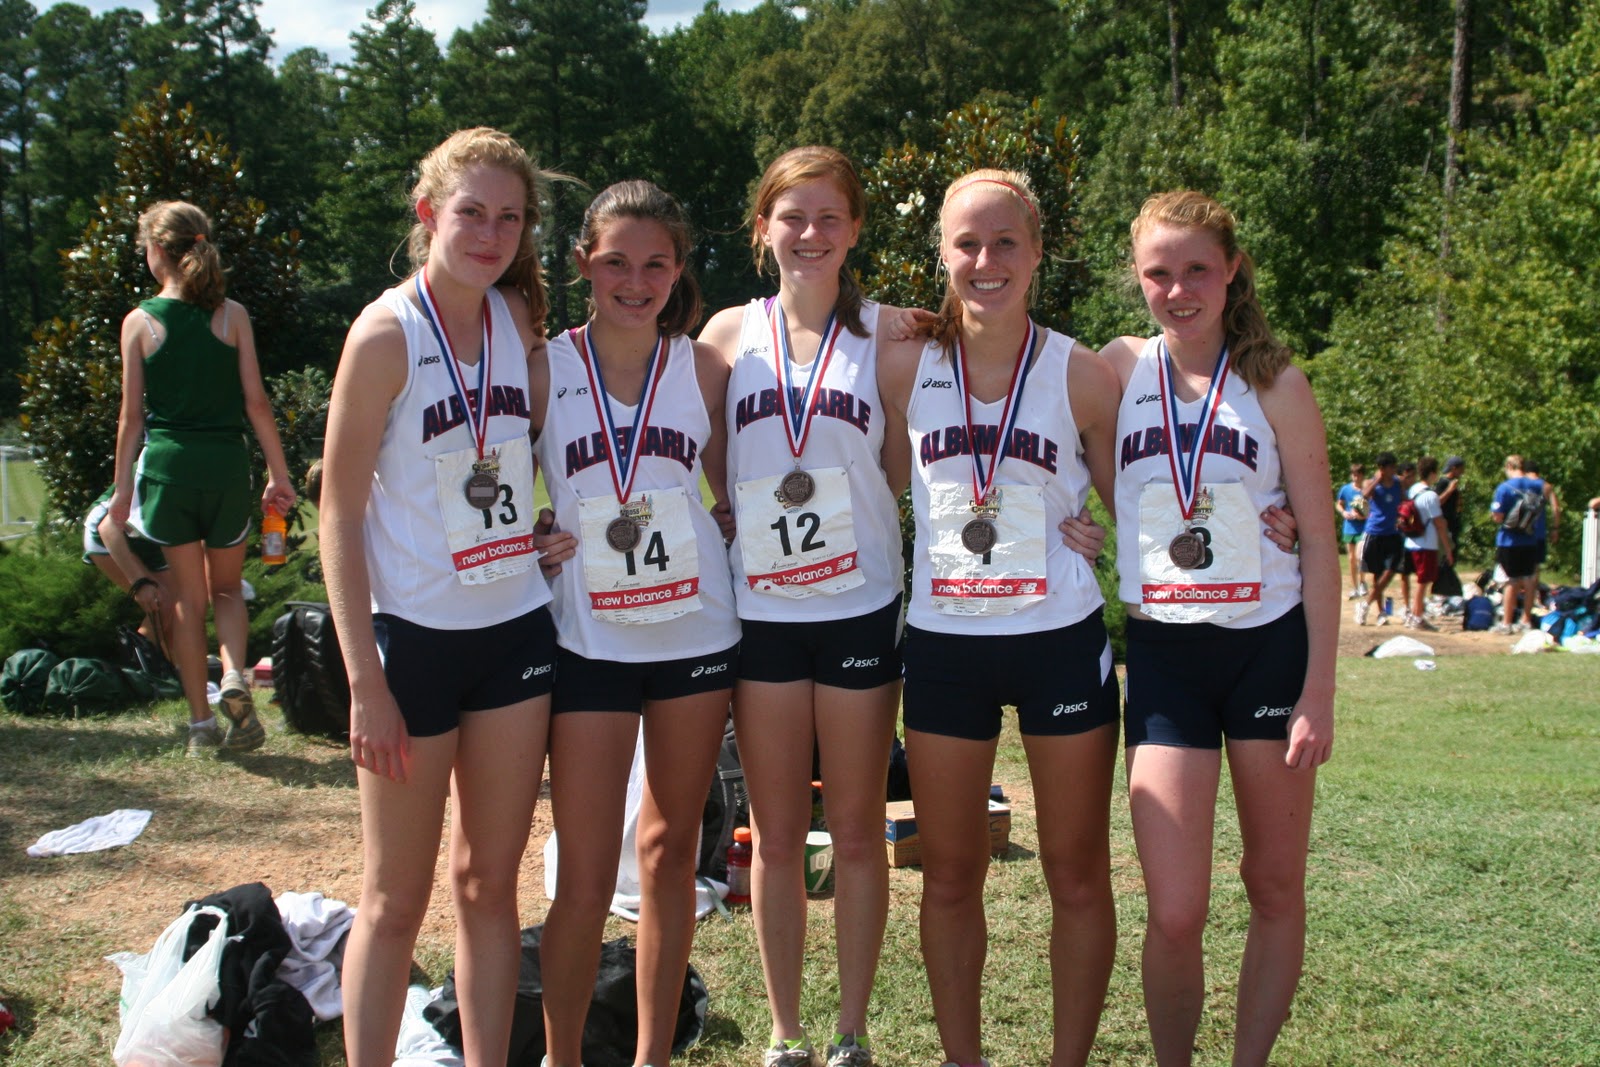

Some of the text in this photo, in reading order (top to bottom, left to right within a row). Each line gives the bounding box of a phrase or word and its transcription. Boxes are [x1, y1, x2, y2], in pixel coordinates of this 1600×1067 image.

[931, 380, 952, 389] asics
[770, 512, 826, 556] 12
[462, 550, 487, 566] new
[488, 541, 527, 557] balance
[782, 566, 832, 584] balance
[938, 584, 961, 594] new
[962, 582, 1013, 594] balance
[1148, 590, 1172, 600] new
[1174, 587, 1228, 600] balance
[597, 597, 621, 607] new
[624, 589, 672, 605] balance
[705, 663, 728, 674] asics
[854, 657, 880, 667] asics
[1064, 701, 1088, 714] asics
